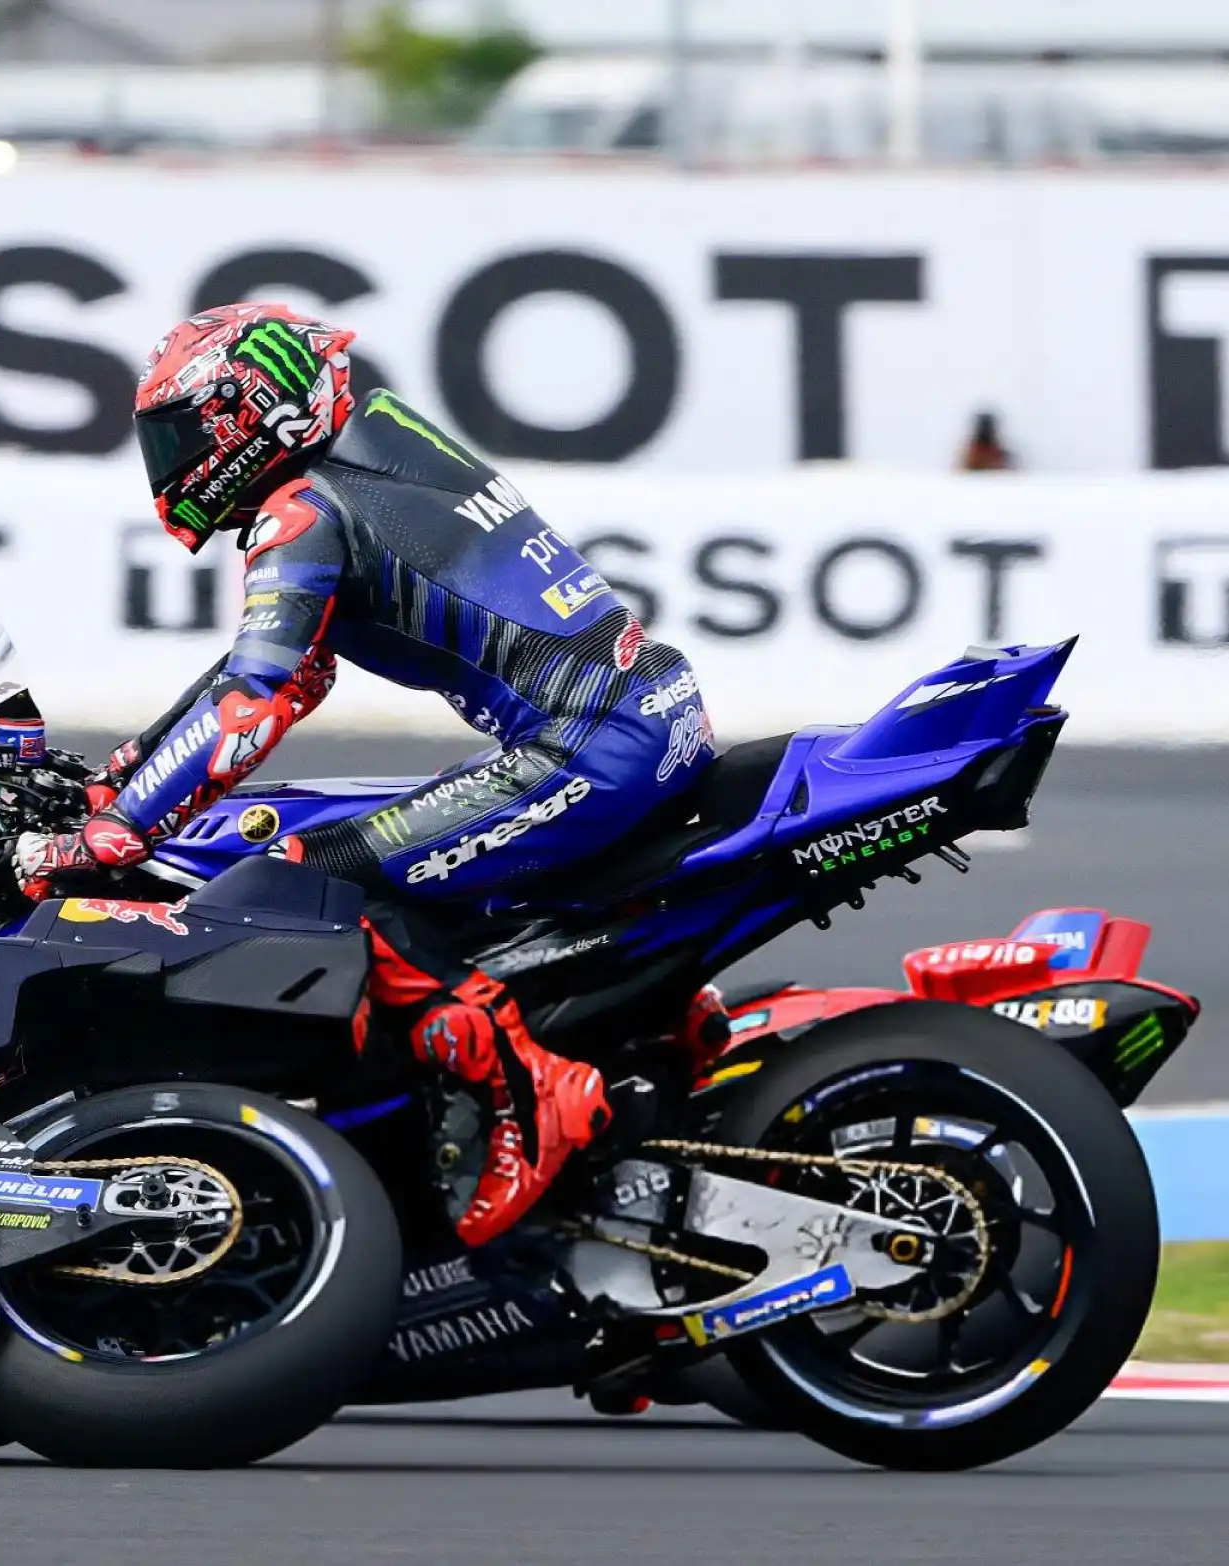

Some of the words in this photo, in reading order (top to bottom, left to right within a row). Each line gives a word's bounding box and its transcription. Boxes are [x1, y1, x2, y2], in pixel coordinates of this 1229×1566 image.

[199, 436, 271, 504] MONSTER
[453, 475, 528, 533] YAM
[130, 711, 221, 801] YAMAHA
[406, 776, 592, 884] alpinestars
[792, 796, 948, 865] MONSTER
[822, 822, 930, 872] ENERGY
[388, 1301, 535, 1362] YAMAHA
